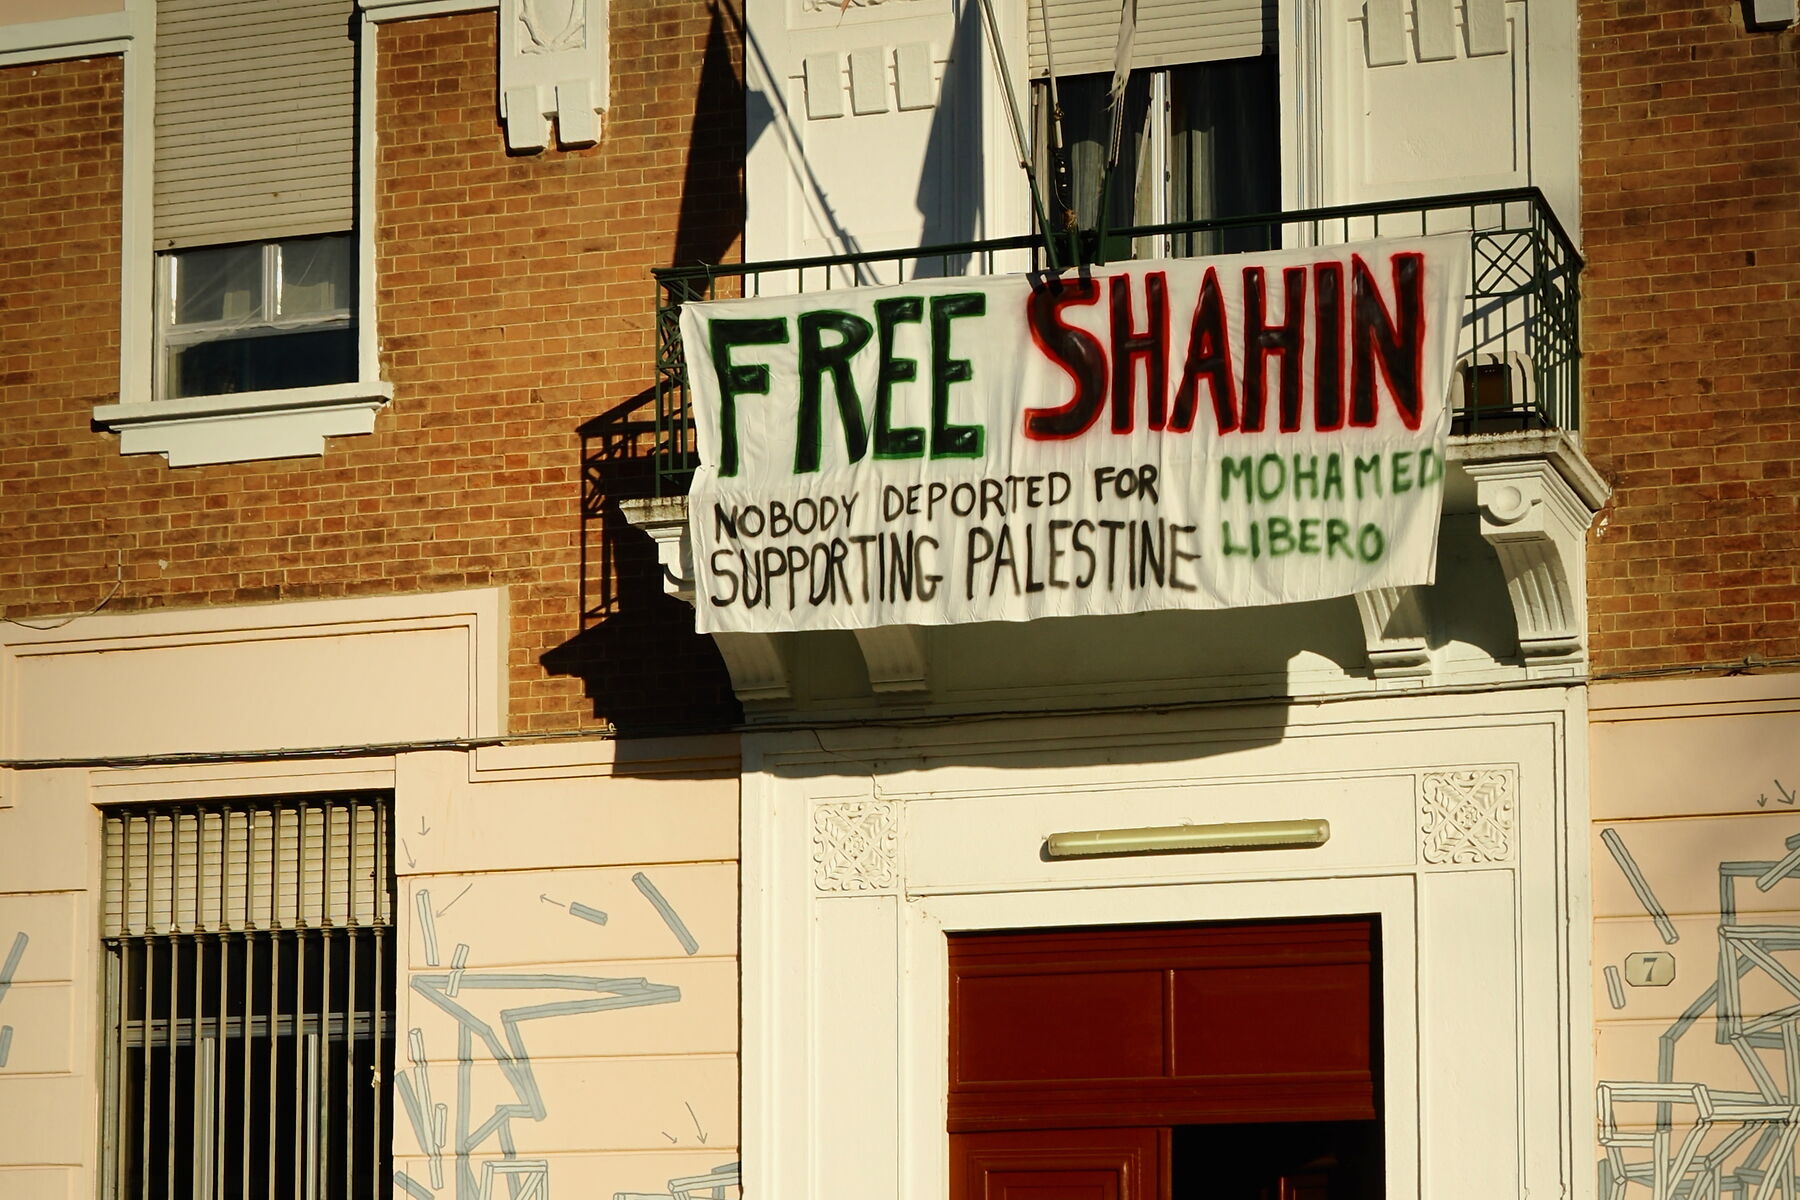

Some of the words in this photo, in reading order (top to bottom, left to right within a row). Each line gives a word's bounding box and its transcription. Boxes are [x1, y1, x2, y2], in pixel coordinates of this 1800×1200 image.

[708, 292, 986, 477] FREE
[1025, 252, 1425, 441] SHAHIN
[714, 491, 859, 543] NOBODY
[883, 471, 1072, 524] DEPORTED
[1094, 464, 1159, 505] FOR
[1220, 447, 1443, 506] MOHAMED
[711, 529, 943, 611] SUPPORTING
[967, 516, 1201, 600] PALESTINE
[1221, 515, 1386, 564] LIBERO
[1643, 957, 1657, 982] 7
